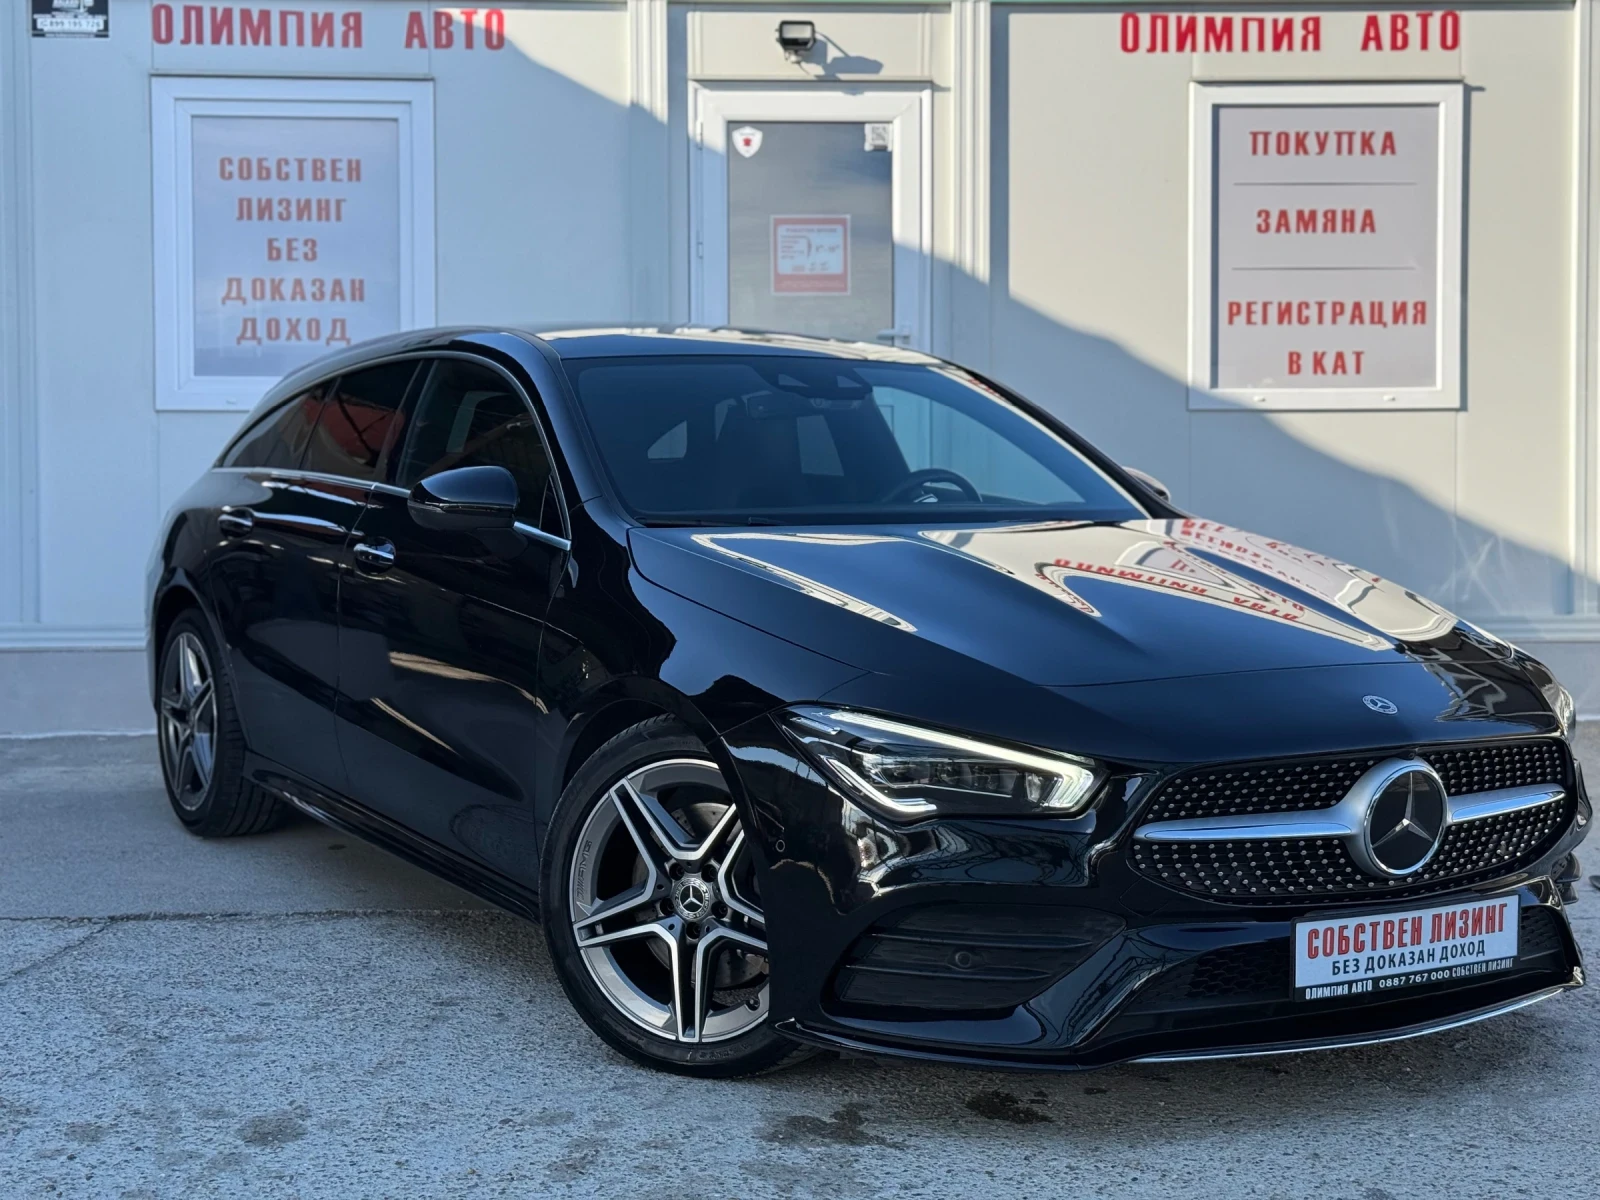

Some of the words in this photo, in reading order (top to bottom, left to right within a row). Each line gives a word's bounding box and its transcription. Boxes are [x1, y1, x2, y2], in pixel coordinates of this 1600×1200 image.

[152, 3, 363, 49] ОЛИМПИЯ
[404, 8, 506, 51] АВТО
[1119, 11, 1322, 53] ОЛИМПИЯ
[1360, 10, 1461, 51] АВТО
[1249, 130, 1397, 156] ПОКУПКА
[219, 156, 362, 183] СОБСТВЕН
[236, 197, 347, 222] ЛИЗИНГ
[1256, 208, 1377, 234] ЗАМЯНА
[267, 237, 318, 262] БЕЗ
[221, 277, 366, 306] ДОКАЗАН
[1227, 300, 1428, 329] РЕГИСТРАЦИЯ
[236, 317, 352, 347] ДОХОД
[1287, 350, 1303, 376] В
[1312, 350, 1365, 376] КАТ
[1307, 915, 1423, 960] СОБСТВЕН
[1429, 902, 1508, 944] ЛИЗИНГ
[1331, 957, 1360, 976] БЕЗ
[1364, 946, 1436, 975] ДОКАЗАН
[1439, 939, 1486, 963] ДОХОД
[1305, 983, 1349, 1000] ОЛИМПИЯ
[1351, 979, 1373, 994] АВТО
[1378, 976, 1406, 989] 0887
[1408, 973, 1429, 984] 767
[1430, 969, 1450, 981] 000
[1451, 961, 1487, 978] СОБСТВЕН
[1487, 957, 1515, 972] ЛИЗИНГ
